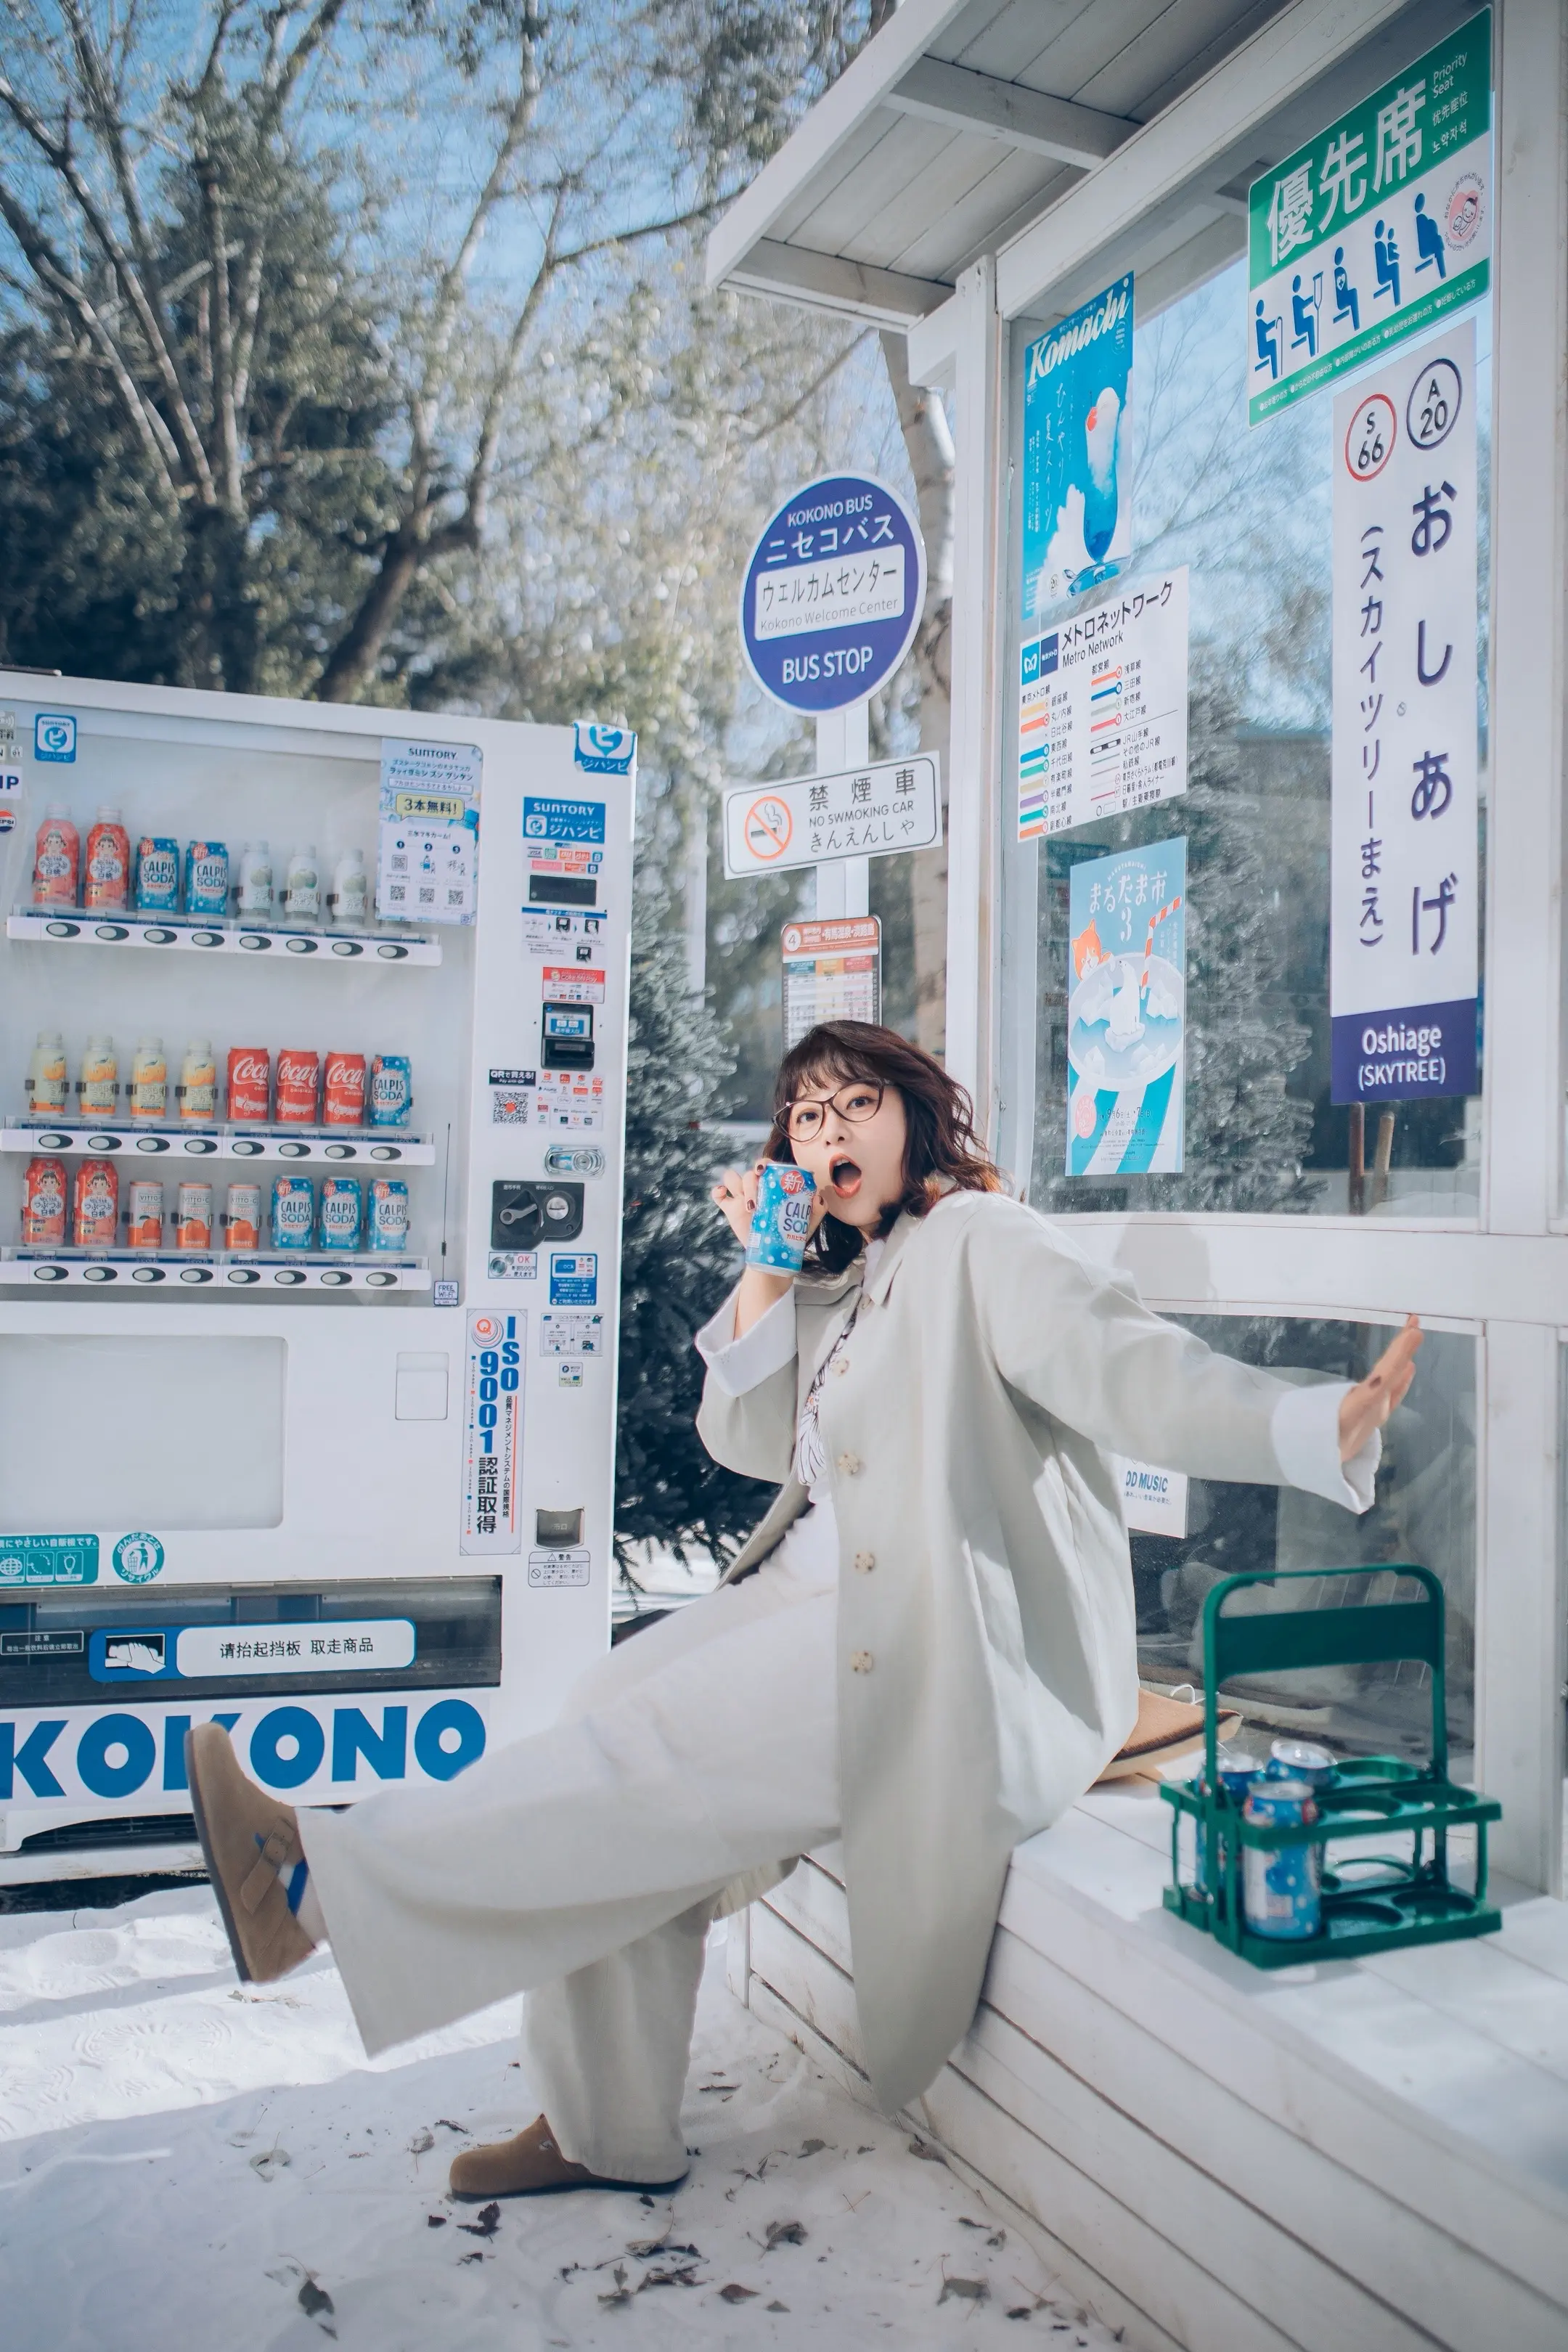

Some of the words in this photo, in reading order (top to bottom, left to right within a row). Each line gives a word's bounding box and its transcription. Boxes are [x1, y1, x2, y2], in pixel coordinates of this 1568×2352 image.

[1433, 52, 1468, 85] Priority
[1433, 75, 1454, 99] Seat
[1432, 118, 1467, 154] 노약자석
[1267, 78, 1426, 267] 優先席
[1028, 277, 1131, 387] Komachi
[1426, 379, 1441, 403] A
[1365, 412, 1376, 436] S
[1420, 400, 1448, 440] 20
[1357, 433, 1384, 472] 66
[787, 501, 844, 528] KOKONO
[845, 494, 873, 516] BUS
[767, 514, 895, 563] ニセコバス
[760, 617, 802, 633] Kokono
[804, 606, 857, 625] Welcome
[859, 597, 899, 615] Center
[1062, 581, 1173, 651] メトロネットワーク
[1062, 648, 1086, 669] Metro
[1087, 629, 1124, 658] Network
[782, 653, 820, 685] BUS
[822, 645, 874, 679] STOP
[1410, 480, 1458, 955] おしあげ
[408, 748, 457, 760] SUNTORY
[809, 768, 916, 812] 禁煙車
[404, 799, 457, 814] 3本無料!
[533, 802, 595, 817] SUNTORY
[809, 816, 825, 829] NO
[827, 805, 889, 825] SWMOKING
[892, 799, 915, 814] CAR
[550, 824, 603, 839] ジハンピ
[143, 859, 176, 875] CALPIS
[143, 873, 176, 885] SODA
[196, 864, 227, 878] CALPIS
[196, 876, 226, 889] SODA
[1090, 870, 1168, 915] まるたま市
[1120, 907, 1132, 943] 3
[1361, 1024, 1443, 1057] Oshiage
[373, 1078, 404, 1091] CALPIS
[1358, 1056, 1446, 1091] (SKYTREE)
[373, 1090, 404, 1101] SODA
[33, 1201, 62, 1211] つぶつぶ
[41, 1209, 57, 1217] 白桃
[84, 1202, 115, 1212] つぶつぶ
[280, 1201, 311, 1213] CALPIS
[280, 1212, 311, 1223] SODA
[325, 1202, 356, 1214] CALPIS
[379, 1204, 407, 1216] CALPIS
[325, 1213, 356, 1224] SODA
[379, 1214, 408, 1225] SODA
[500, 1316, 520, 1392] ISO
[479, 1351, 499, 1454] 9001
[1138, 1472, 1169, 1493] MUSIC
[477, 1457, 498, 1535] 認証取得
[116, 1532, 162, 1555] のんだあとは
[119, 1567, 160, 1585] リサイクル
[220, 1639, 302, 1659] 请抬起挡板
[310, 1637, 374, 1656] 取走商品
